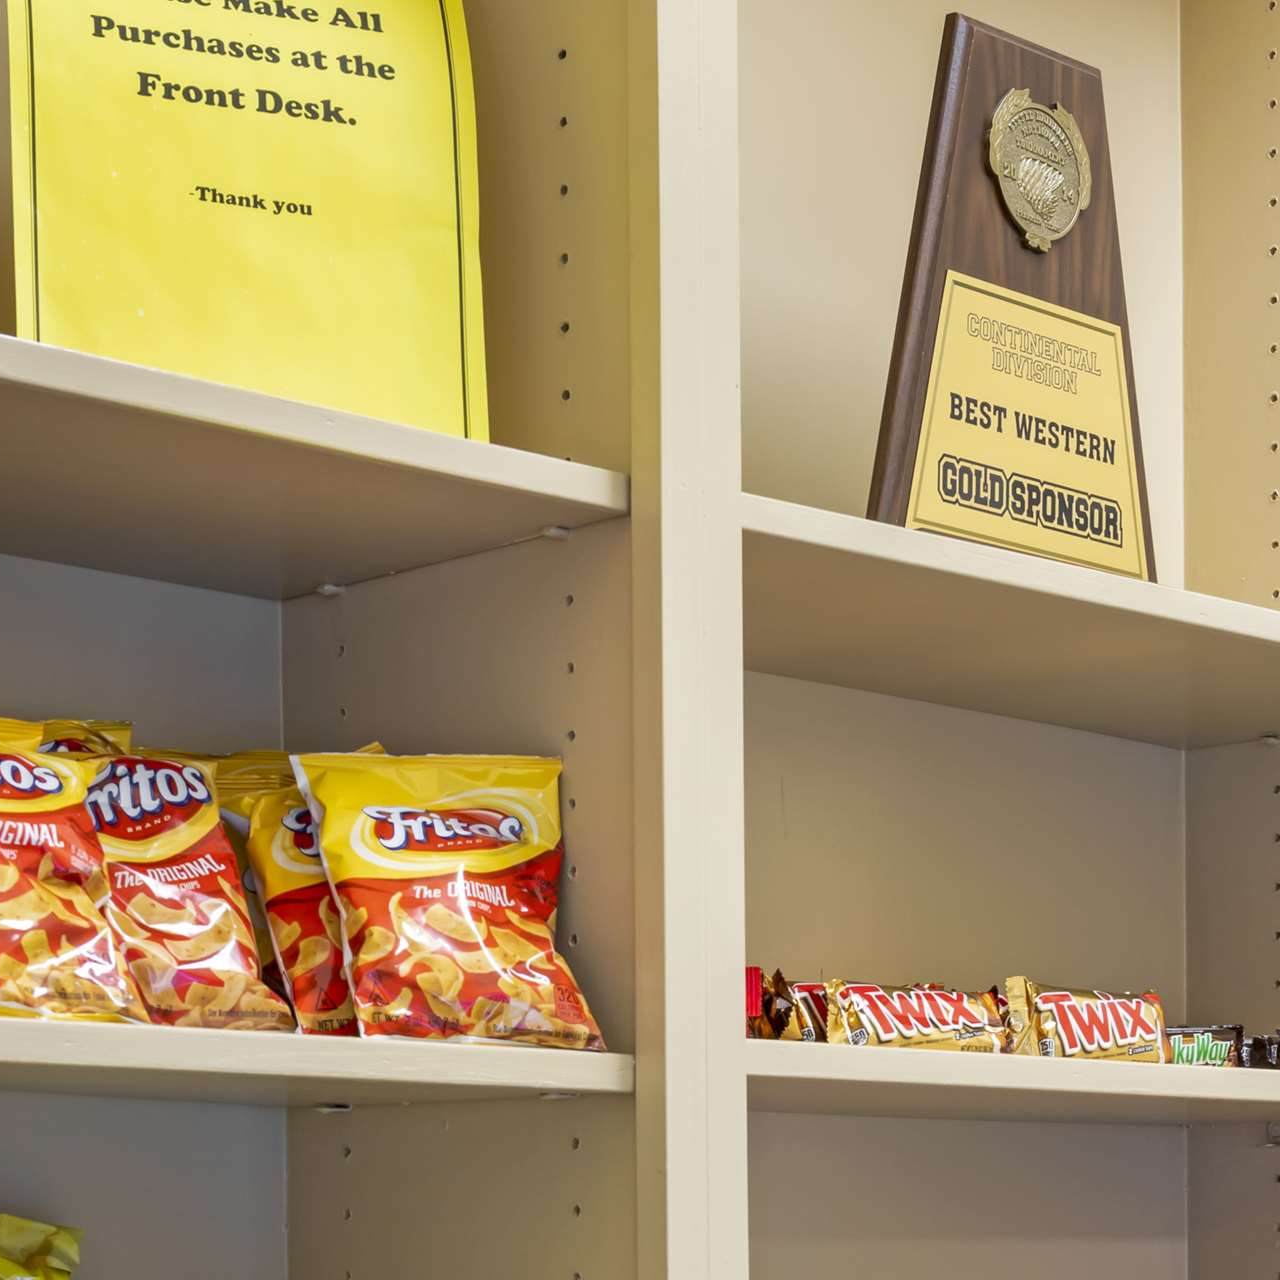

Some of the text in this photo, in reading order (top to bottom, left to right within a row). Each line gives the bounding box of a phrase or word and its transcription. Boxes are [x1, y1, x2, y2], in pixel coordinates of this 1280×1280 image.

[222, 0, 384, 33] Make All
[90, 15, 396, 80] Purchases at the
[136, 72, 357, 126] Front Desk.
[272, 198, 313, 216] you
[967, 313, 1101, 376] CONTINENTAL
[992, 348, 1078, 394] DIVISION
[949, 392, 1116, 465] BEST WESTERN
[939, 455, 1122, 546] GOLD SPONSOR
[126, 814, 172, 833] BRAND
[114, 854, 226, 889] The ORIGINAL
[413, 881, 516, 907] The ORIGINAL
